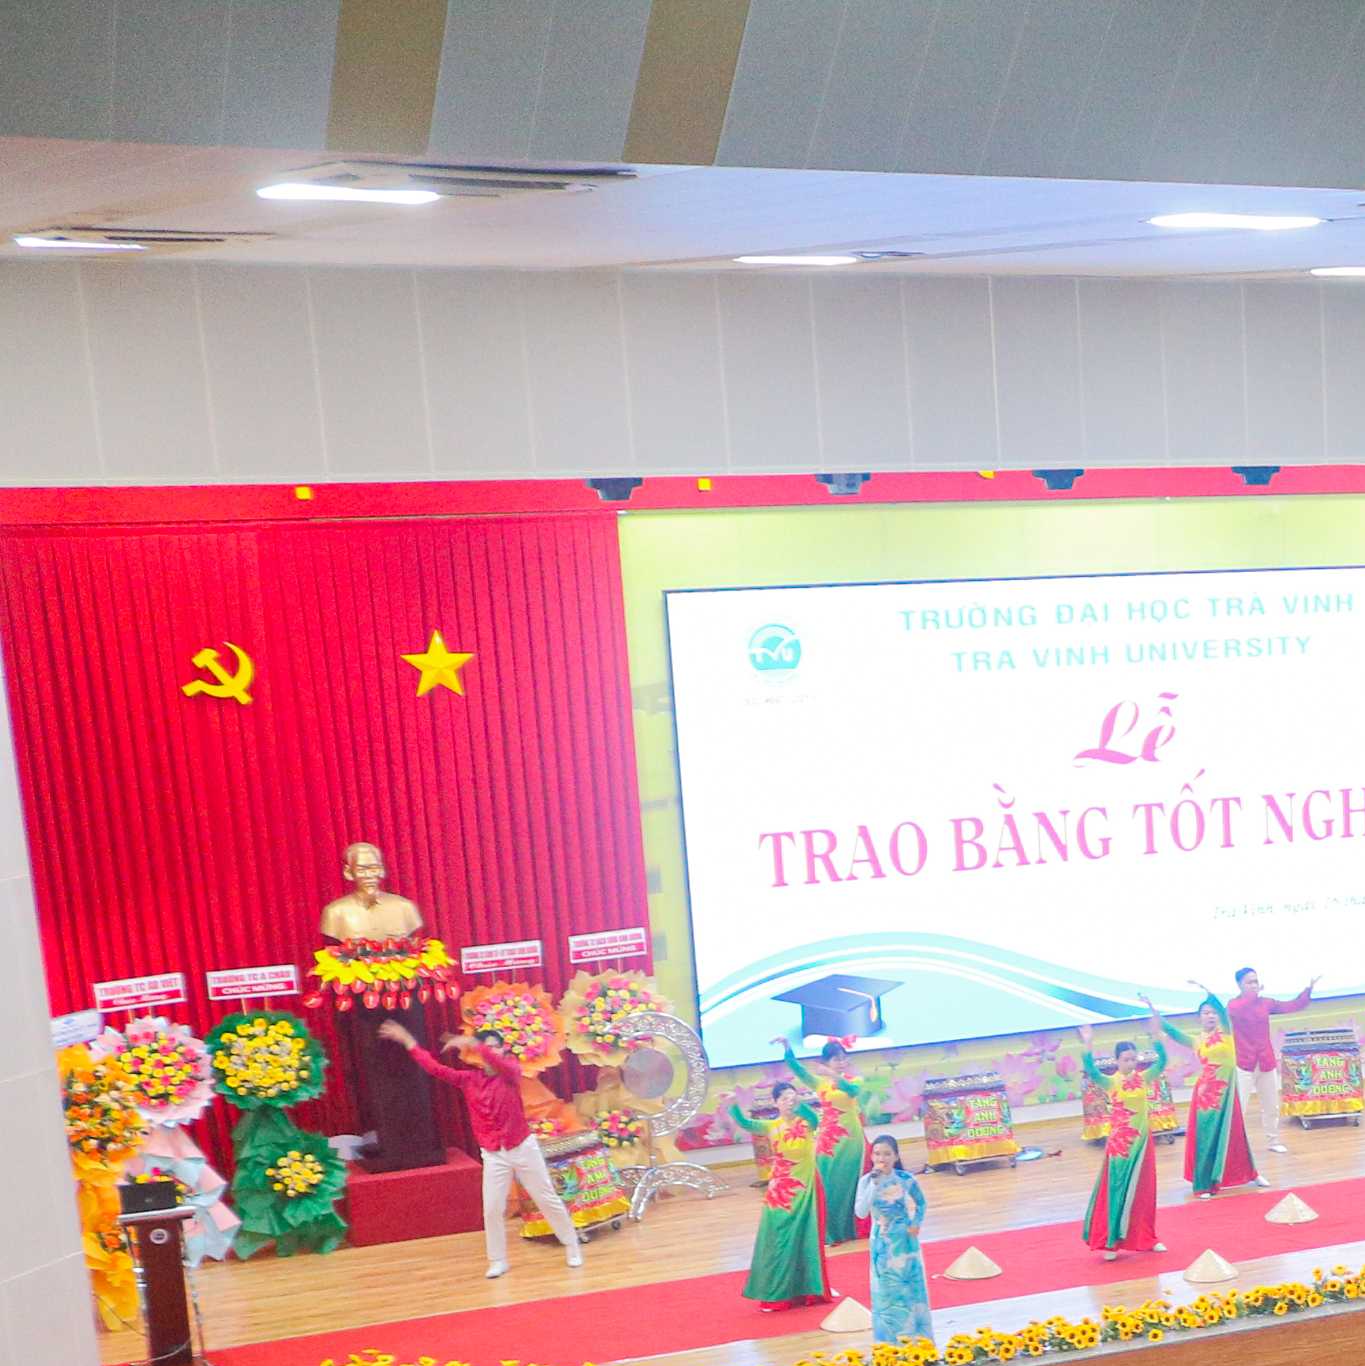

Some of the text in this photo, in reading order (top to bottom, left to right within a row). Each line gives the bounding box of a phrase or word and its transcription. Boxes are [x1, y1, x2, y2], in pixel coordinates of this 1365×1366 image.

[901, 605, 1037, 631] TRƯỜNG
[1056, 603, 1108, 624] ĐẠI
[1128, 599, 1189, 623] HỌC
[1283, 594, 1352, 614] VINH
[952, 637, 1309, 672] TRA VINH UNIVERSITY
[1076, 693, 1178, 764] Lễ
[760, 822, 927, 887] TRAO
[951, 784, 1111, 871] BẰNG
[1134, 769, 1241, 854] TỐT
